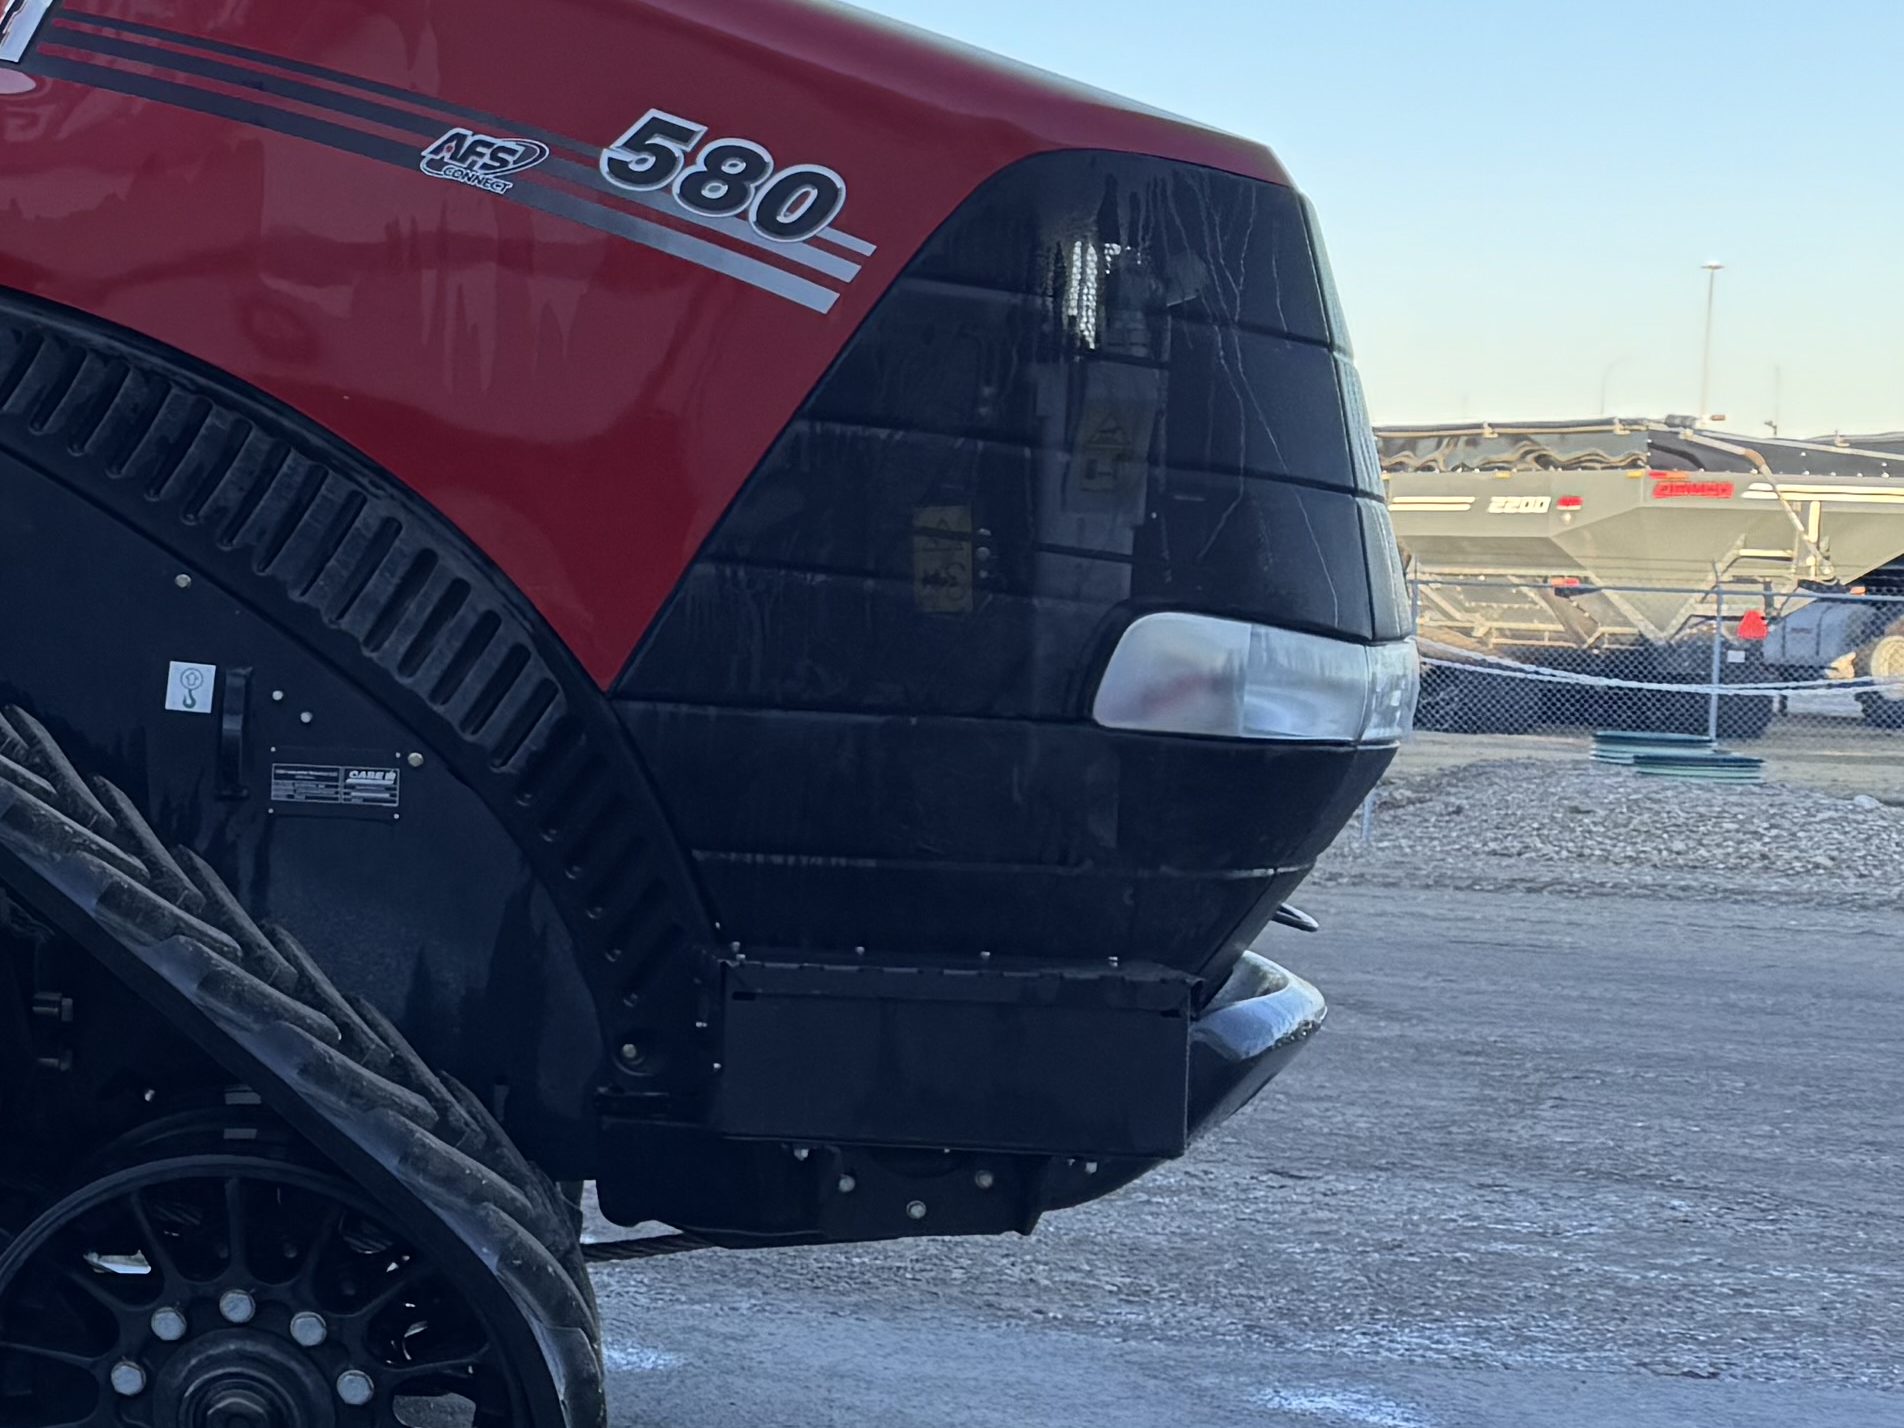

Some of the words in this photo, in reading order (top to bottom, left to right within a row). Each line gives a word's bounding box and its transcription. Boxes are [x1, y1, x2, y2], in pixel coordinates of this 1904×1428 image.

[422, 128, 525, 170] AFS
[442, 165, 513, 194] CONNECT
[599, 108, 847, 243] 580
[1488, 496, 1551, 513] 2200
